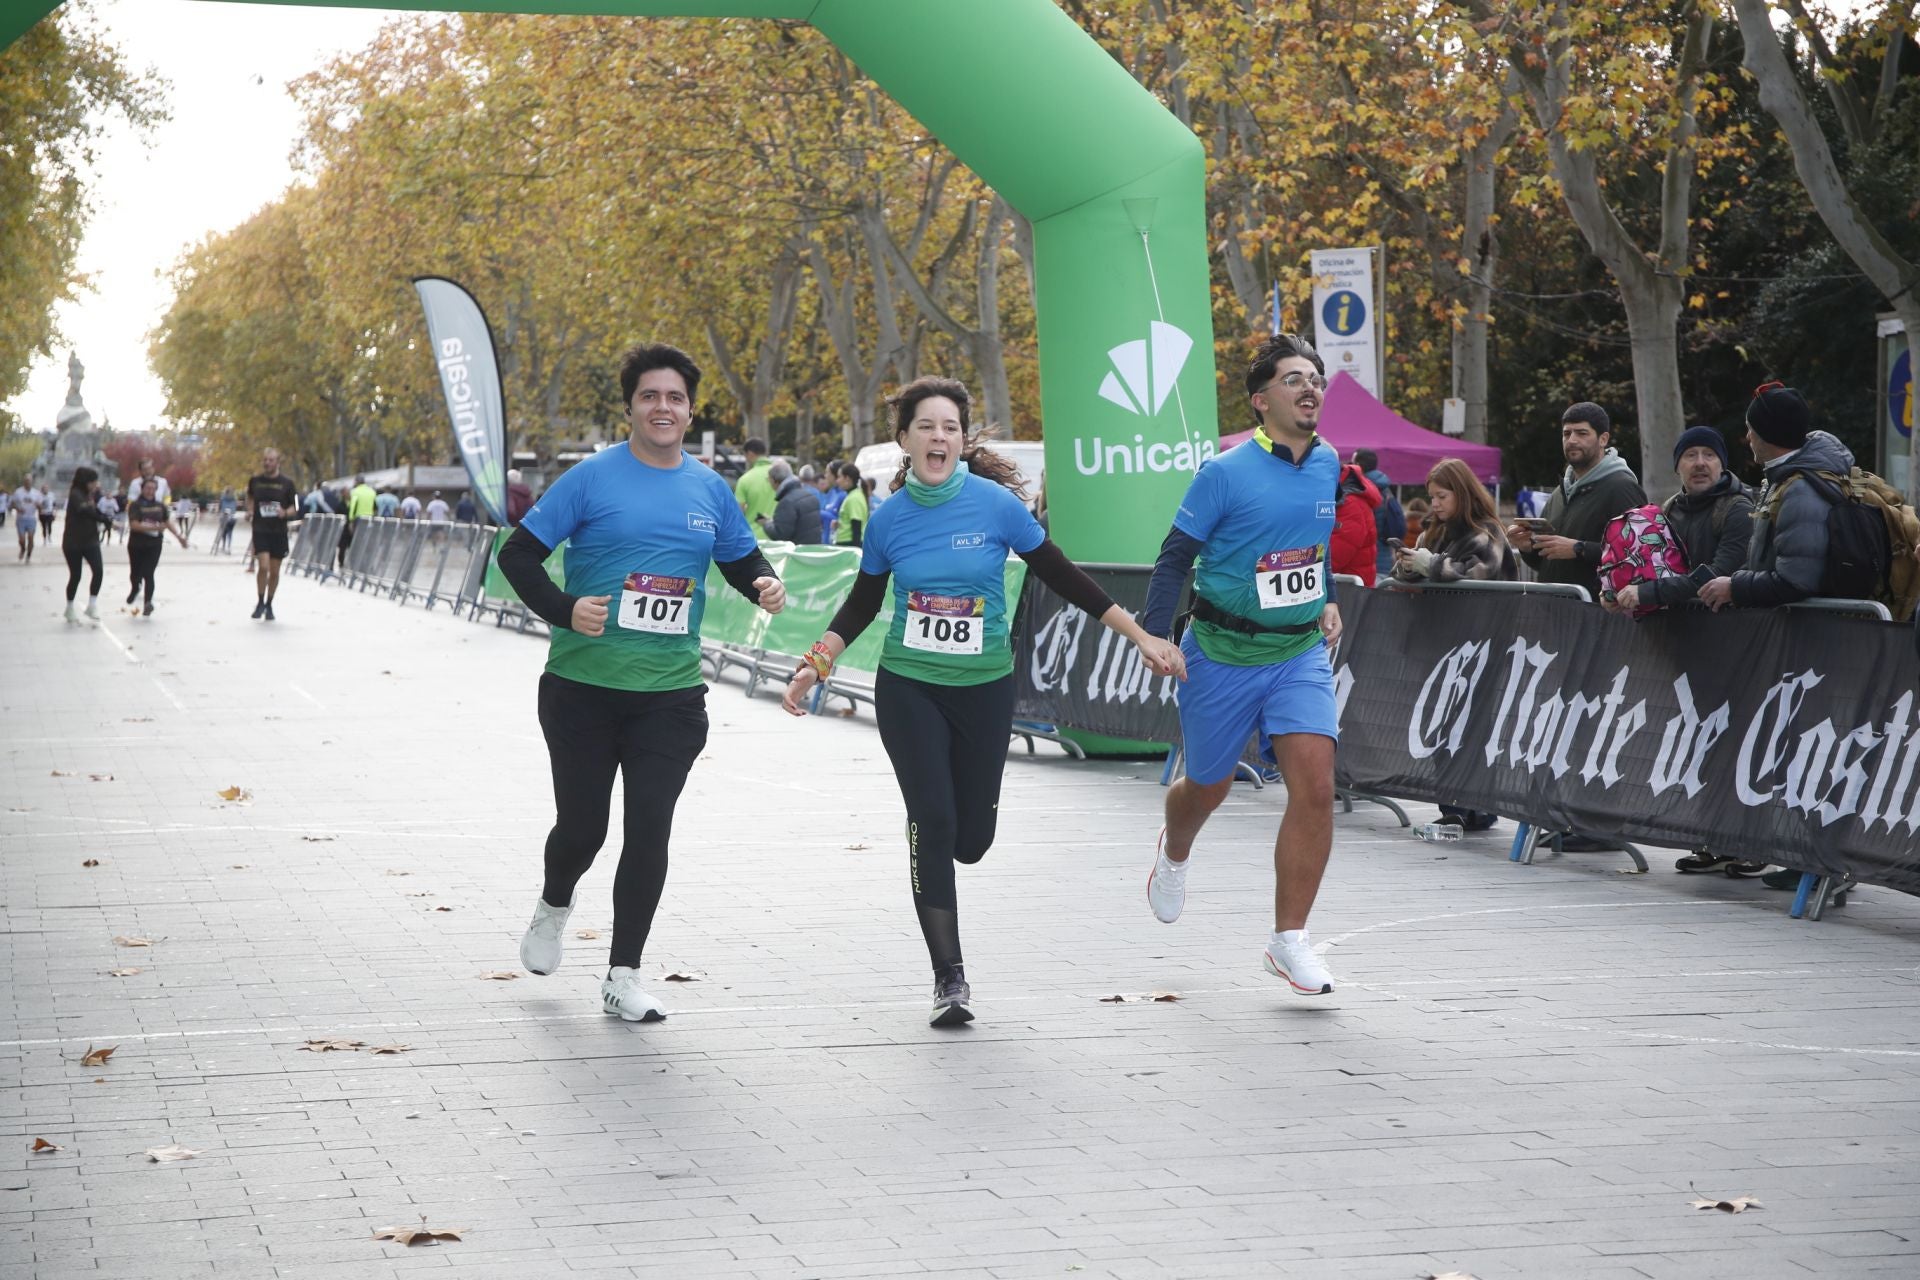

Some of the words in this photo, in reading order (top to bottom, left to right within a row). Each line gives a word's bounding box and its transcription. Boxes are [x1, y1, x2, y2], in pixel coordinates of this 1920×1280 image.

[1074, 430, 1215, 477] Unicaja
[1270, 568, 1316, 596] 106
[634, 596, 682, 622] 107
[918, 616, 970, 643] 108
[1409, 638, 1491, 759] El
[1485, 635, 1647, 790] Norte
[1647, 672, 1730, 800] de
[912, 857, 922, 894] NIKE
